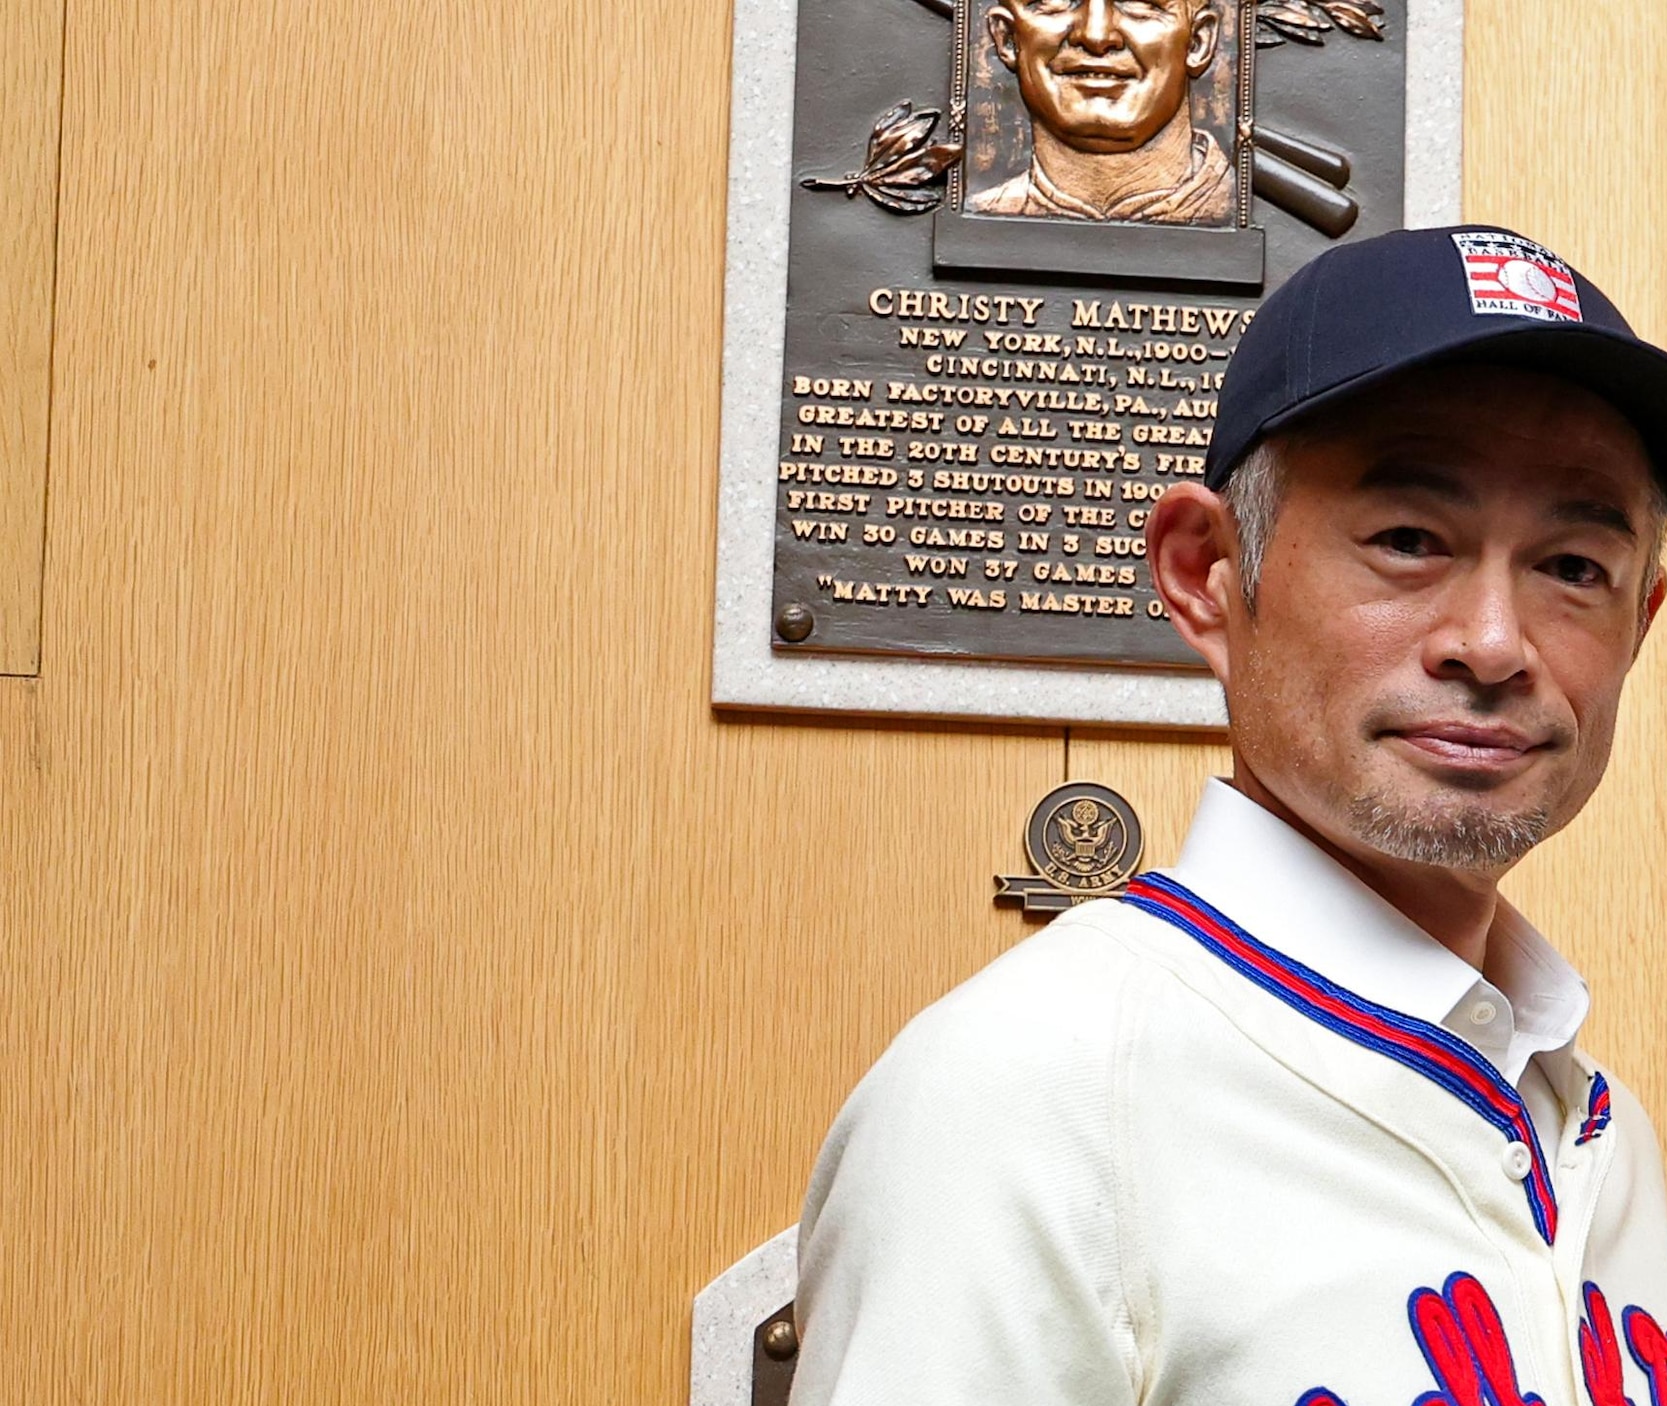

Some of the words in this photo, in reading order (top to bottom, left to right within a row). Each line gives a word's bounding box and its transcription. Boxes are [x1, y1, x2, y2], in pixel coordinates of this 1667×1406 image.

[869, 288, 1044, 325] CHRISTY
[1476, 299, 1519, 311] HALL
[1523, 303, 1542, 315] OF
[899, 327, 968, 349] NEW
[793, 376, 873, 398] BORN
[926, 354, 1117, 389] CINCINNATI,
[798, 405, 945, 432] GREATEST
[955, 414, 990, 435] OF
[999, 417, 1058, 438] ALL
[1069, 421, 1122, 443] THE
[791, 434, 825, 454] IN
[838, 437, 895, 458] THE
[908, 442, 979, 463] 20TH
[990, 446, 1141, 472] CENTURY'S
[778, 462, 898, 487] PITCHED
[907, 469, 924, 489] 3
[933, 471, 1074, 497] SHUTOUTS
[1084, 479, 1114, 499] IN
[1120, 481, 1173, 501] 190
[787, 490, 870, 513] FIRST
[886, 496, 1005, 521] PITCHER
[1017, 503, 1052, 523] OF
[1062, 506, 1116, 527] THE
[792, 519, 849, 542] WIN
[863, 524, 896, 544] 30
[909, 527, 1005, 550] GAMES
[1017, 532, 1049, 552] IN
[1063, 534, 1080, 554] 3
[904, 554, 968, 577] WON
[984, 558, 1019, 579] 37
[1033, 562, 1137, 585] GAMES
[817, 575, 932, 604] "MATTY
[947, 588, 1007, 609] WAS
[1020, 592, 1135, 616] MASTER
[1078, 864, 1124, 888] ARMY
